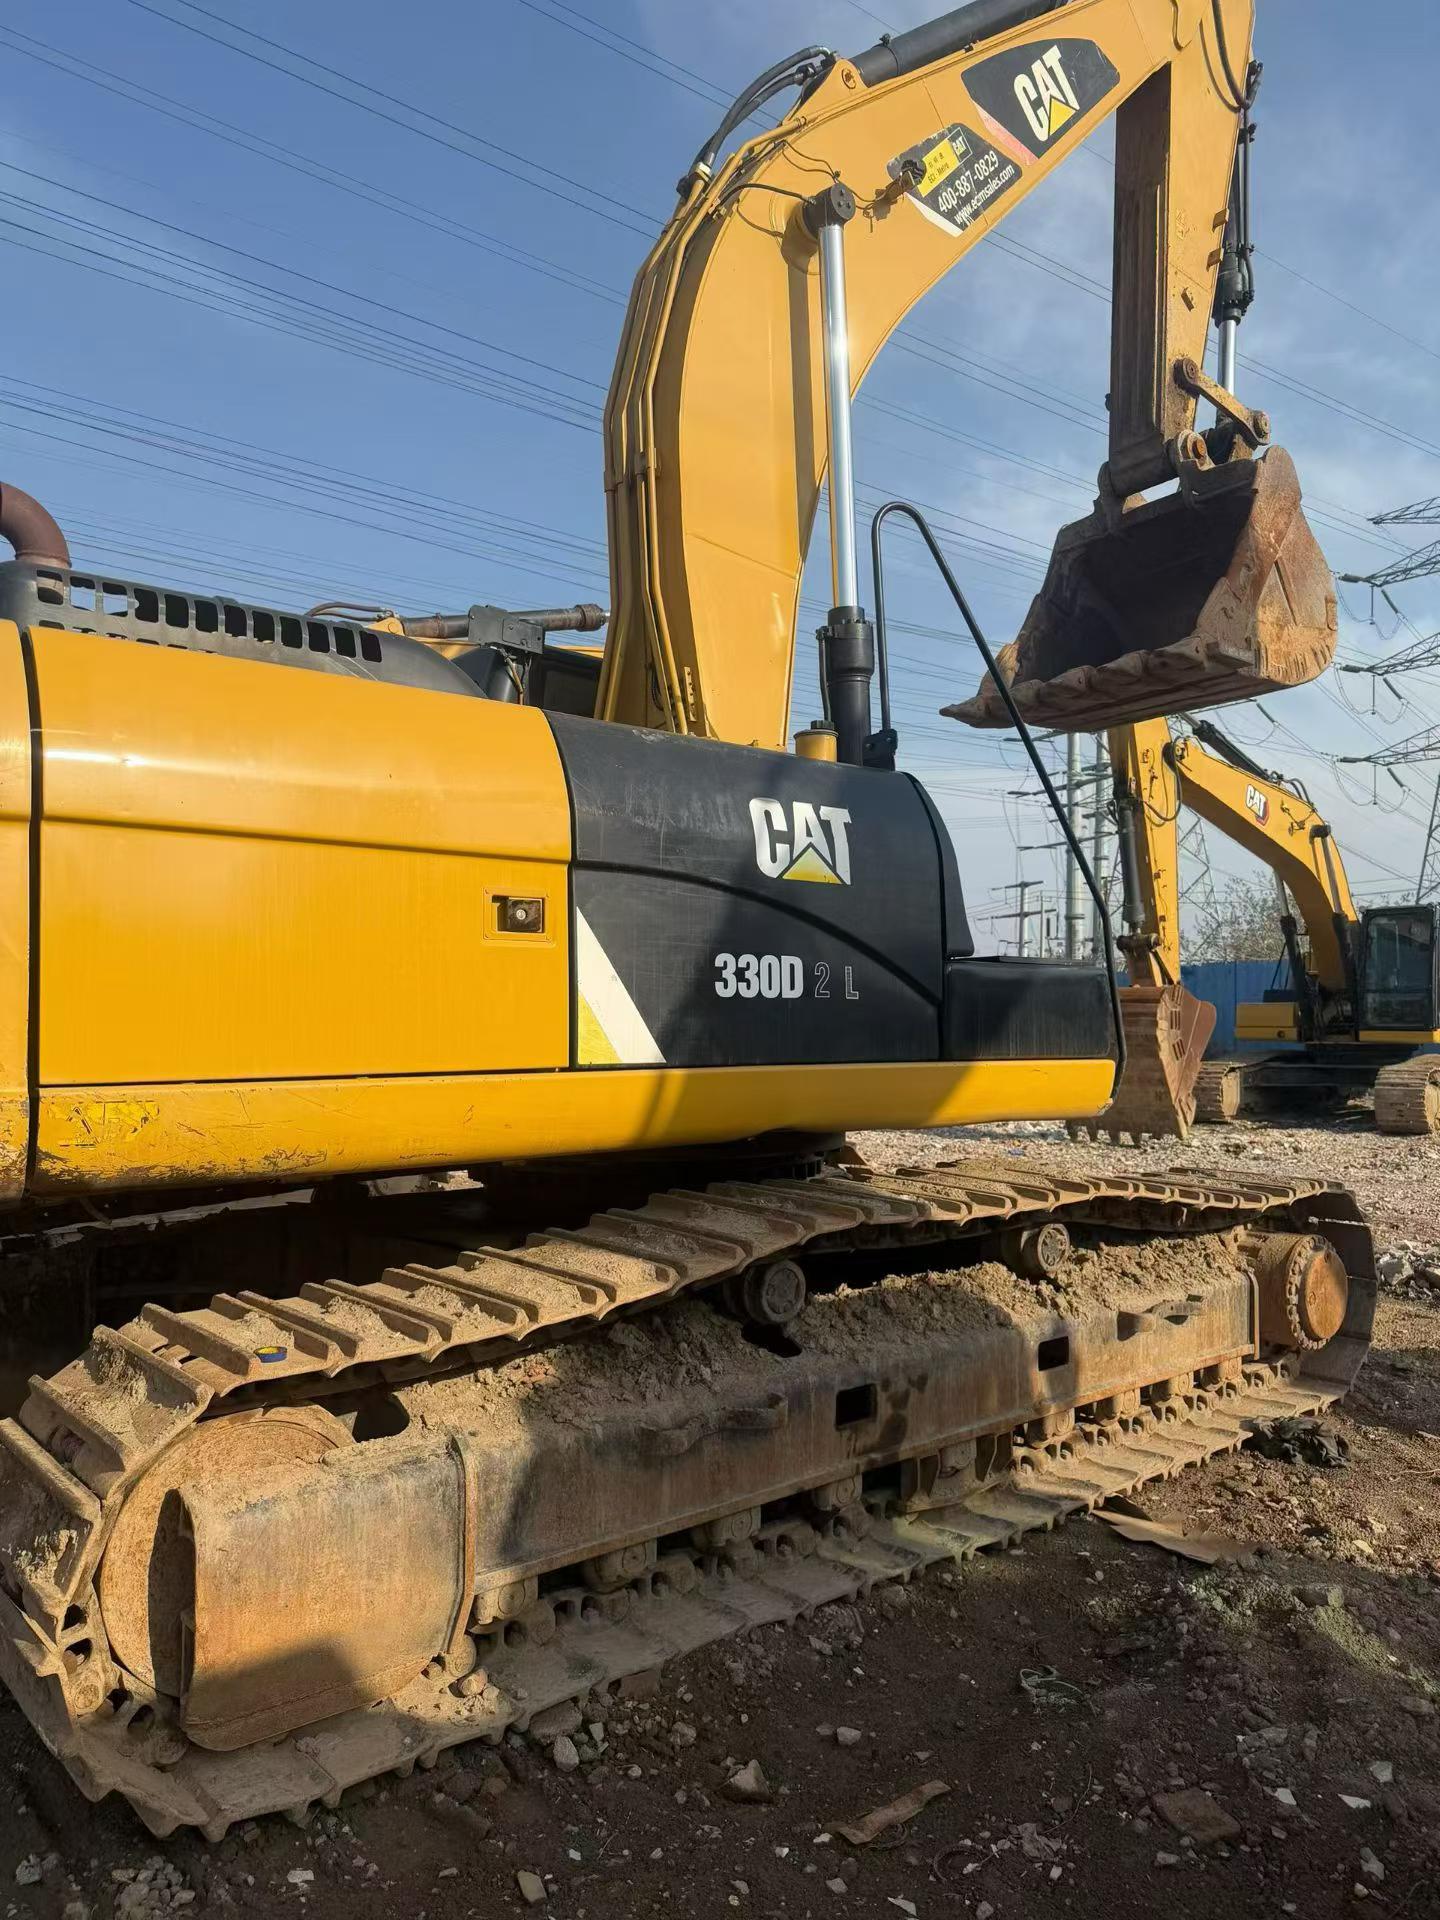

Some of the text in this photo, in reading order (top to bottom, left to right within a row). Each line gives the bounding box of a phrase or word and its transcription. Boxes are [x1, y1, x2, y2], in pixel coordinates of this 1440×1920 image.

[1014, 45, 1080, 142] CAT
[952, 136, 966, 156] CAT
[938, 150, 999, 213] 400-887-0829
[1246, 784, 1267, 818] CAT
[749, 797, 852, 885] CAT
[714, 953, 859, 1000] 330D 2 L
